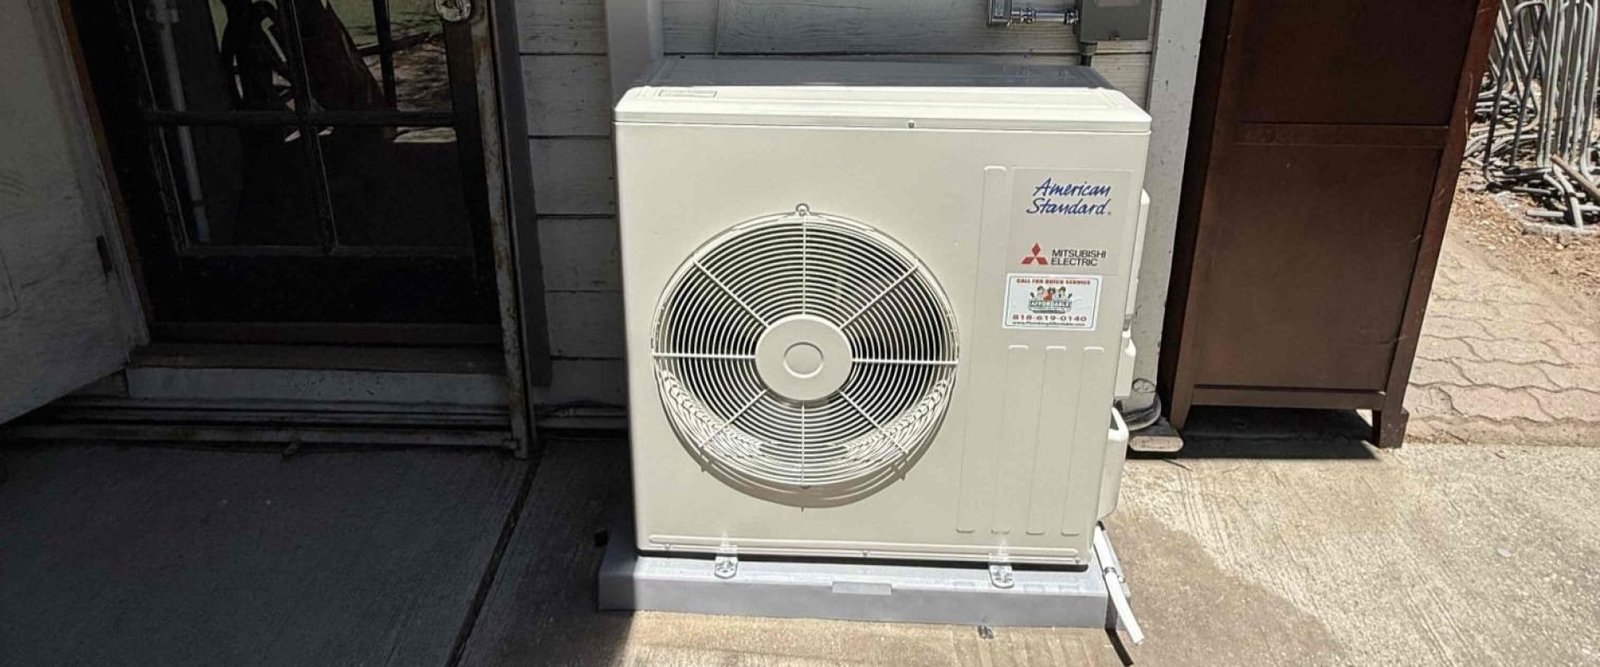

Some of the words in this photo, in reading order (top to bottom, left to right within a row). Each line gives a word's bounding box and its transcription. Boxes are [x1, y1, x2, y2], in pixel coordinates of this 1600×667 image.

[1033, 178, 1111, 197] American
[1052, 249, 1106, 258] MITSUBISHI
[1051, 258, 1098, 266] ELECTRIC
[1012, 314, 1087, 322] 818-619-0140
